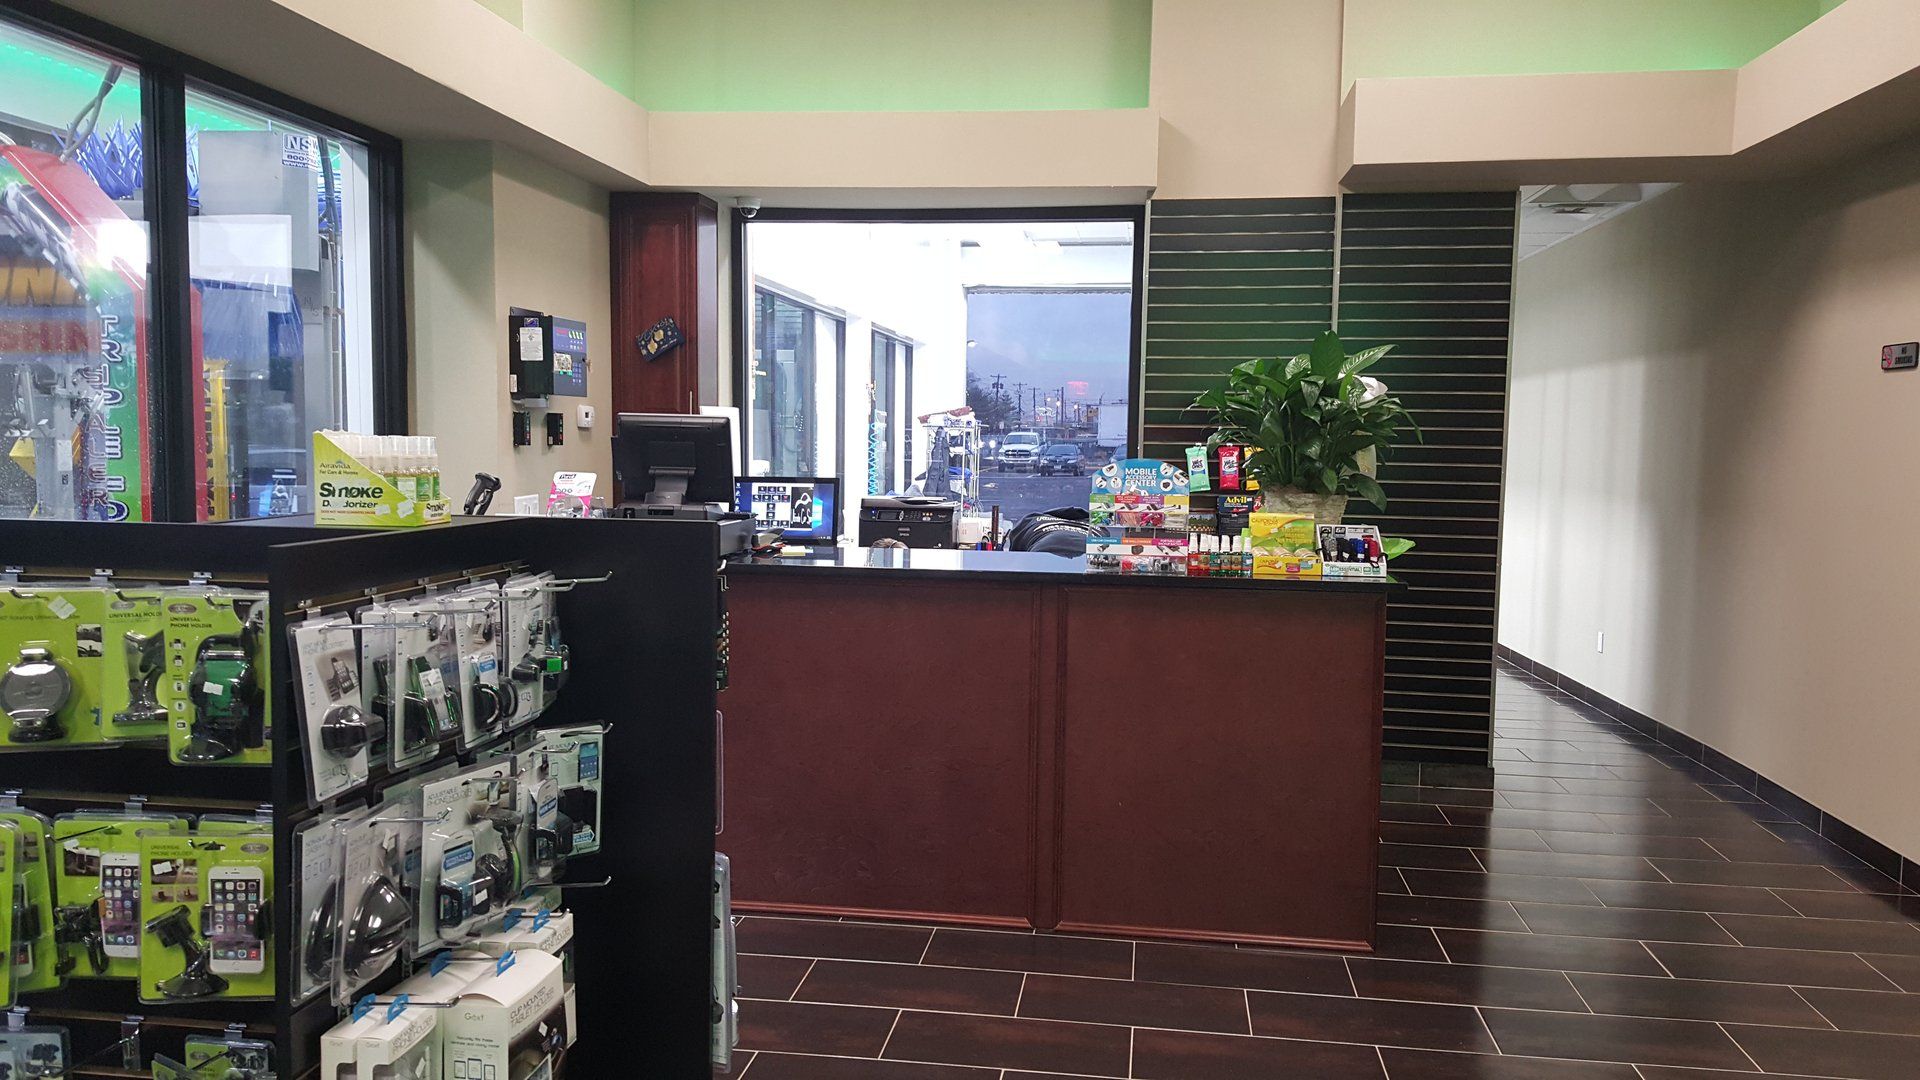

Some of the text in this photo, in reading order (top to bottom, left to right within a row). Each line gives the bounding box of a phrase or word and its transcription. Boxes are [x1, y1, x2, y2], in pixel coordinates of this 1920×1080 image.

[83, 367, 108, 507] SALER
[1125, 467, 1158, 476] MOBILE
[1125, 480, 1157, 488] CENTER
[319, 482, 384, 498] Smoke
[322, 499, 379, 508] Dorizer
[1225, 496, 1247, 504] Advil
